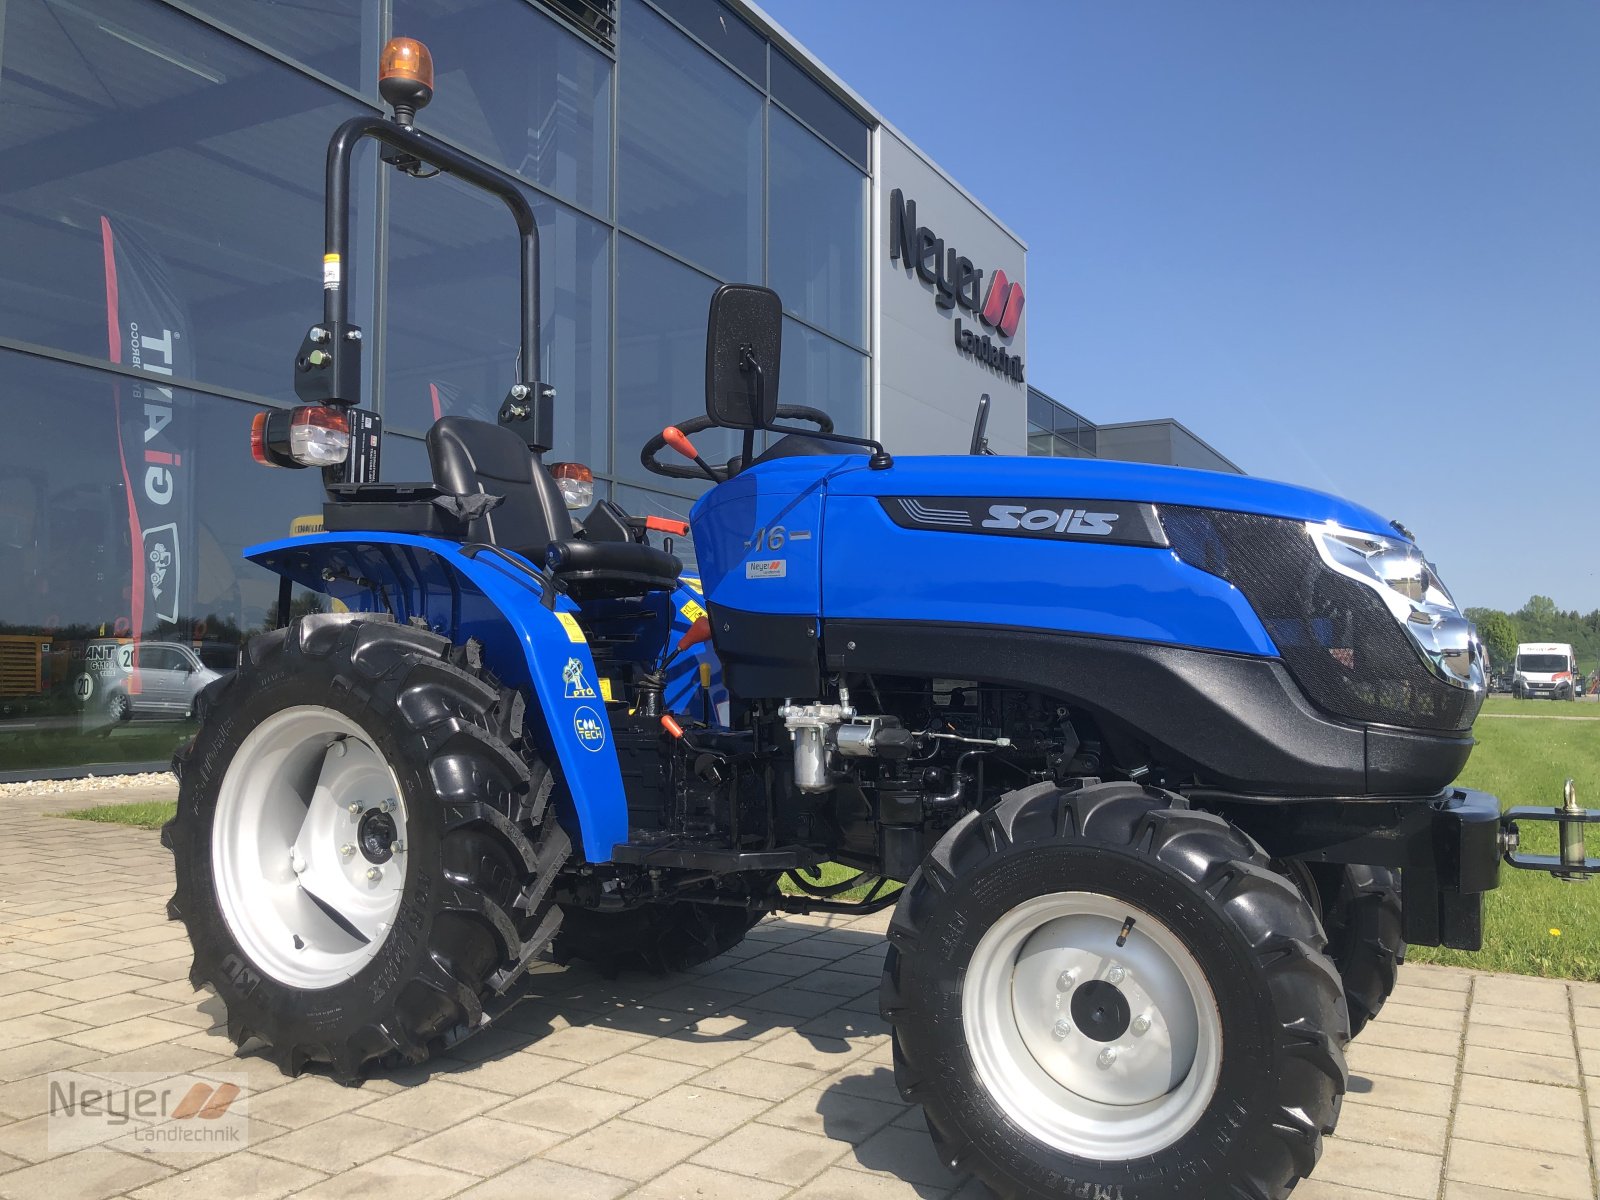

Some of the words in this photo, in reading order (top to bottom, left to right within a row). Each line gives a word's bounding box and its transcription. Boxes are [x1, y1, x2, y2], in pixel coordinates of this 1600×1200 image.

[890, 188, 983, 313] Neyer
[78, 678, 89, 695] 20
[573, 688, 594, 698] PTO
[578, 729, 603, 740] TECH
